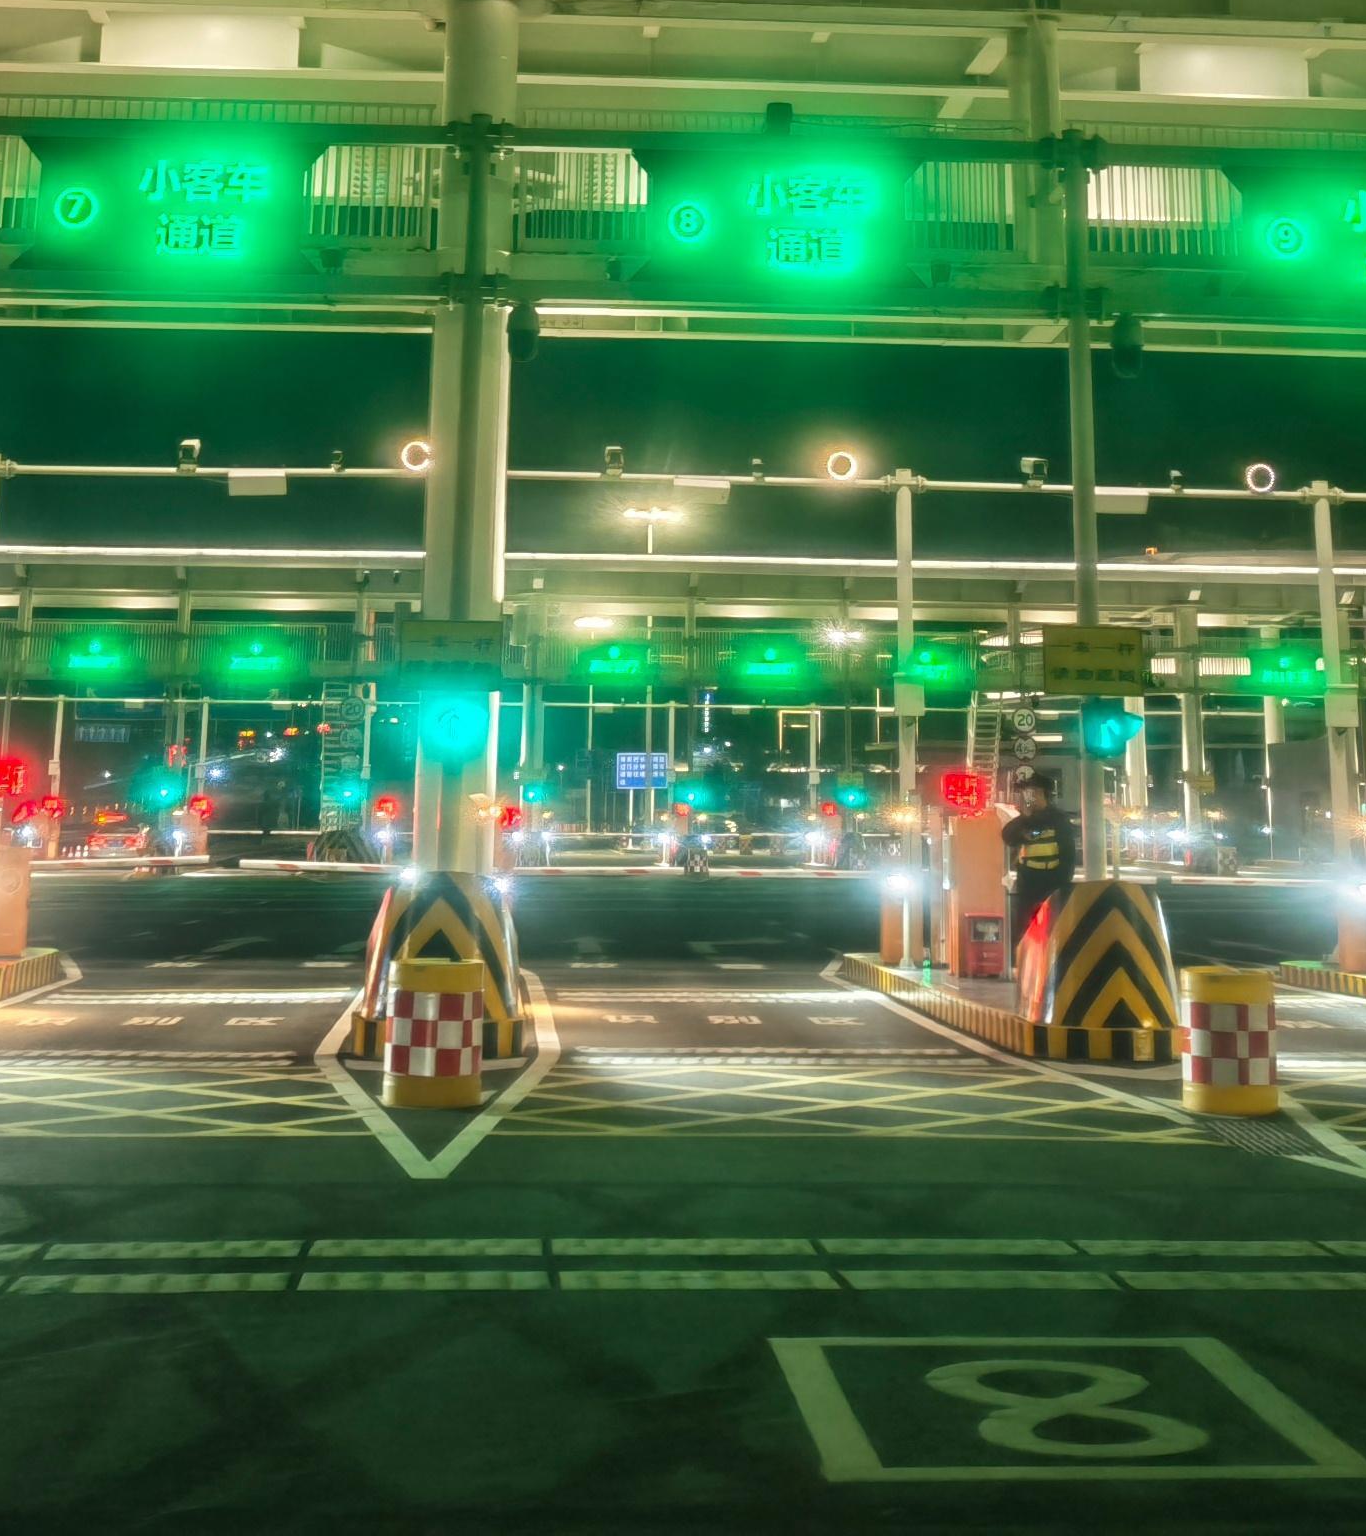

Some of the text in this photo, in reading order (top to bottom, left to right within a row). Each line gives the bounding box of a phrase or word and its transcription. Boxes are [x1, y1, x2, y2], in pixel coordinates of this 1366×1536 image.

[138, 159, 270, 204] 小客车
[155, 213, 243, 257] 通道
[1017, 713, 1034, 727] 20
[923, 1358, 1210, 1459] 8
